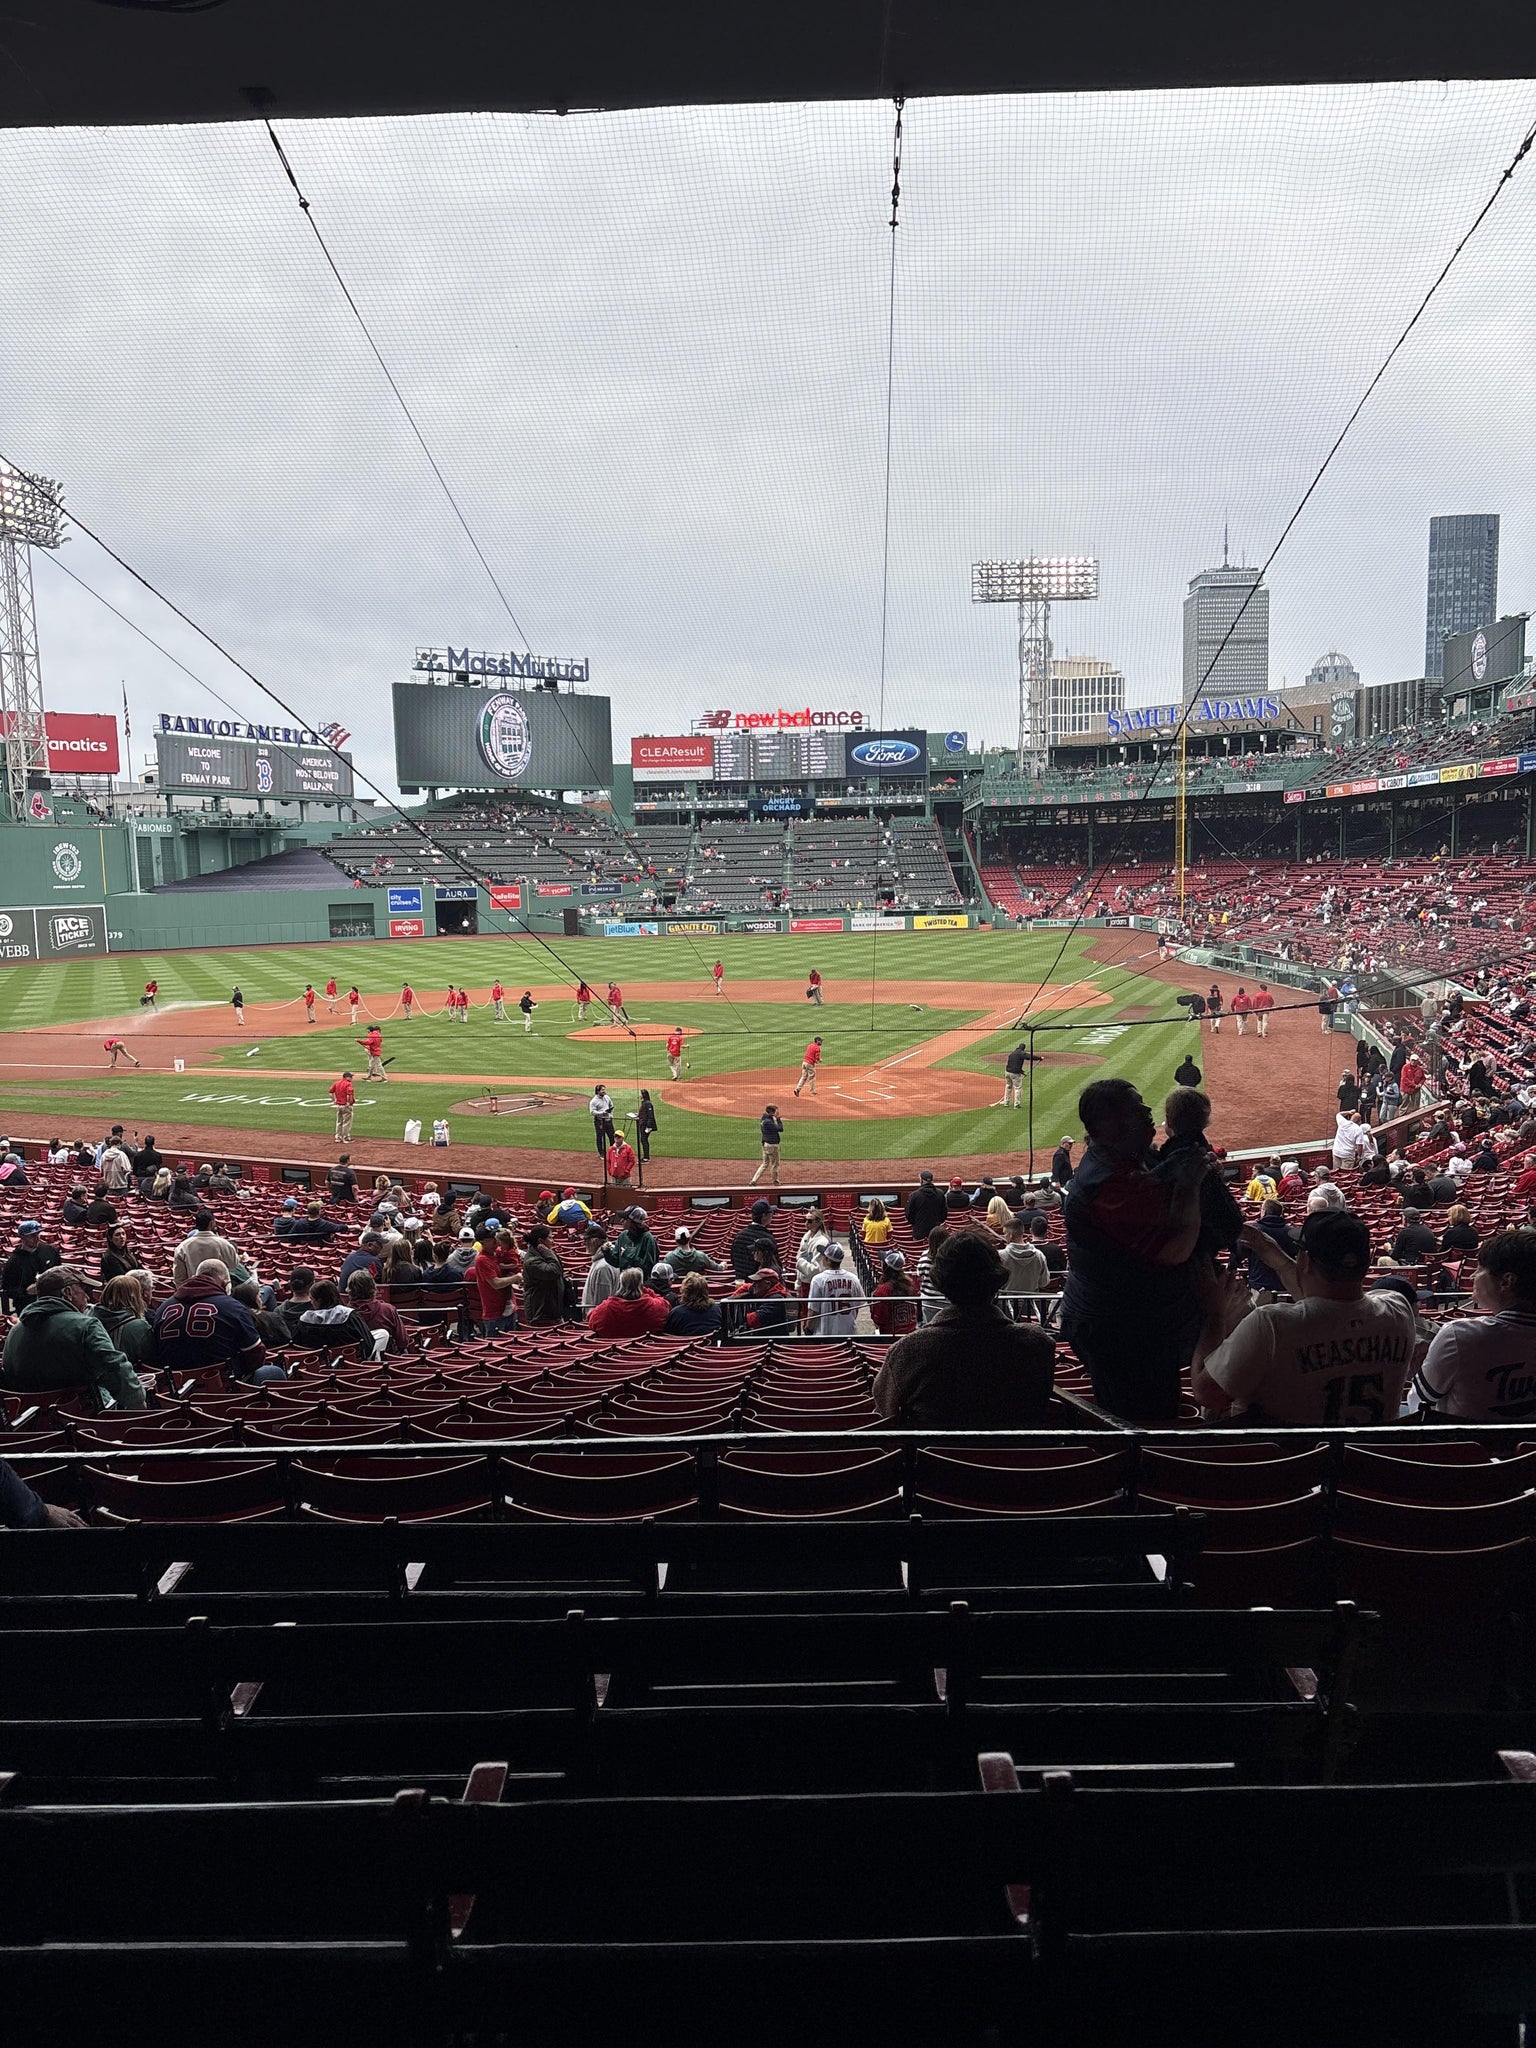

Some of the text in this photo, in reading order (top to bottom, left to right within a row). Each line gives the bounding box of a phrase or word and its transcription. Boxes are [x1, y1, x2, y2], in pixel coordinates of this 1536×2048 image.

[448, 646, 589, 682] MassMutual
[487, 696, 514, 716] FENWAY
[1200, 695, 1280, 721] ADAMS
[735, 712, 775, 728] new
[778, 707, 863, 728] balance
[161, 714, 320, 746] BANK OF AMERICA
[188, 747, 221, 758] WELCOME
[640, 746, 704, 757] CLEAResult
[865, 744, 906, 762] Ford
[201, 762, 210, 771] TO
[302, 757, 332, 768] AMERICA'S
[295, 768, 339, 780] MOST BELOVED
[181, 774, 231, 786] FENWAY PARK
[302, 781, 334, 792] BALLPARK
[137, 824, 172, 833] ABIOMED
[53, 843, 69, 855] IBEW
[551, 886, 571, 894] TICKET
[390, 894, 402, 902] city
[58, 917, 89, 934] ACE
[395, 924, 419, 932] IRVING
[668, 922, 718, 933] GRANITE CITY
[746, 921, 777, 930] wasabi
[924, 919, 958, 928] TWISTED TEA
[109, 931, 123, 939] 379
[608, 924, 635, 935] jetBlue
[59, 929, 90, 943] TICKET
[826, 1279, 853, 1292] DURAN
[159, 1302, 219, 1339] 26
[1322, 1372, 1384, 1426] 15
